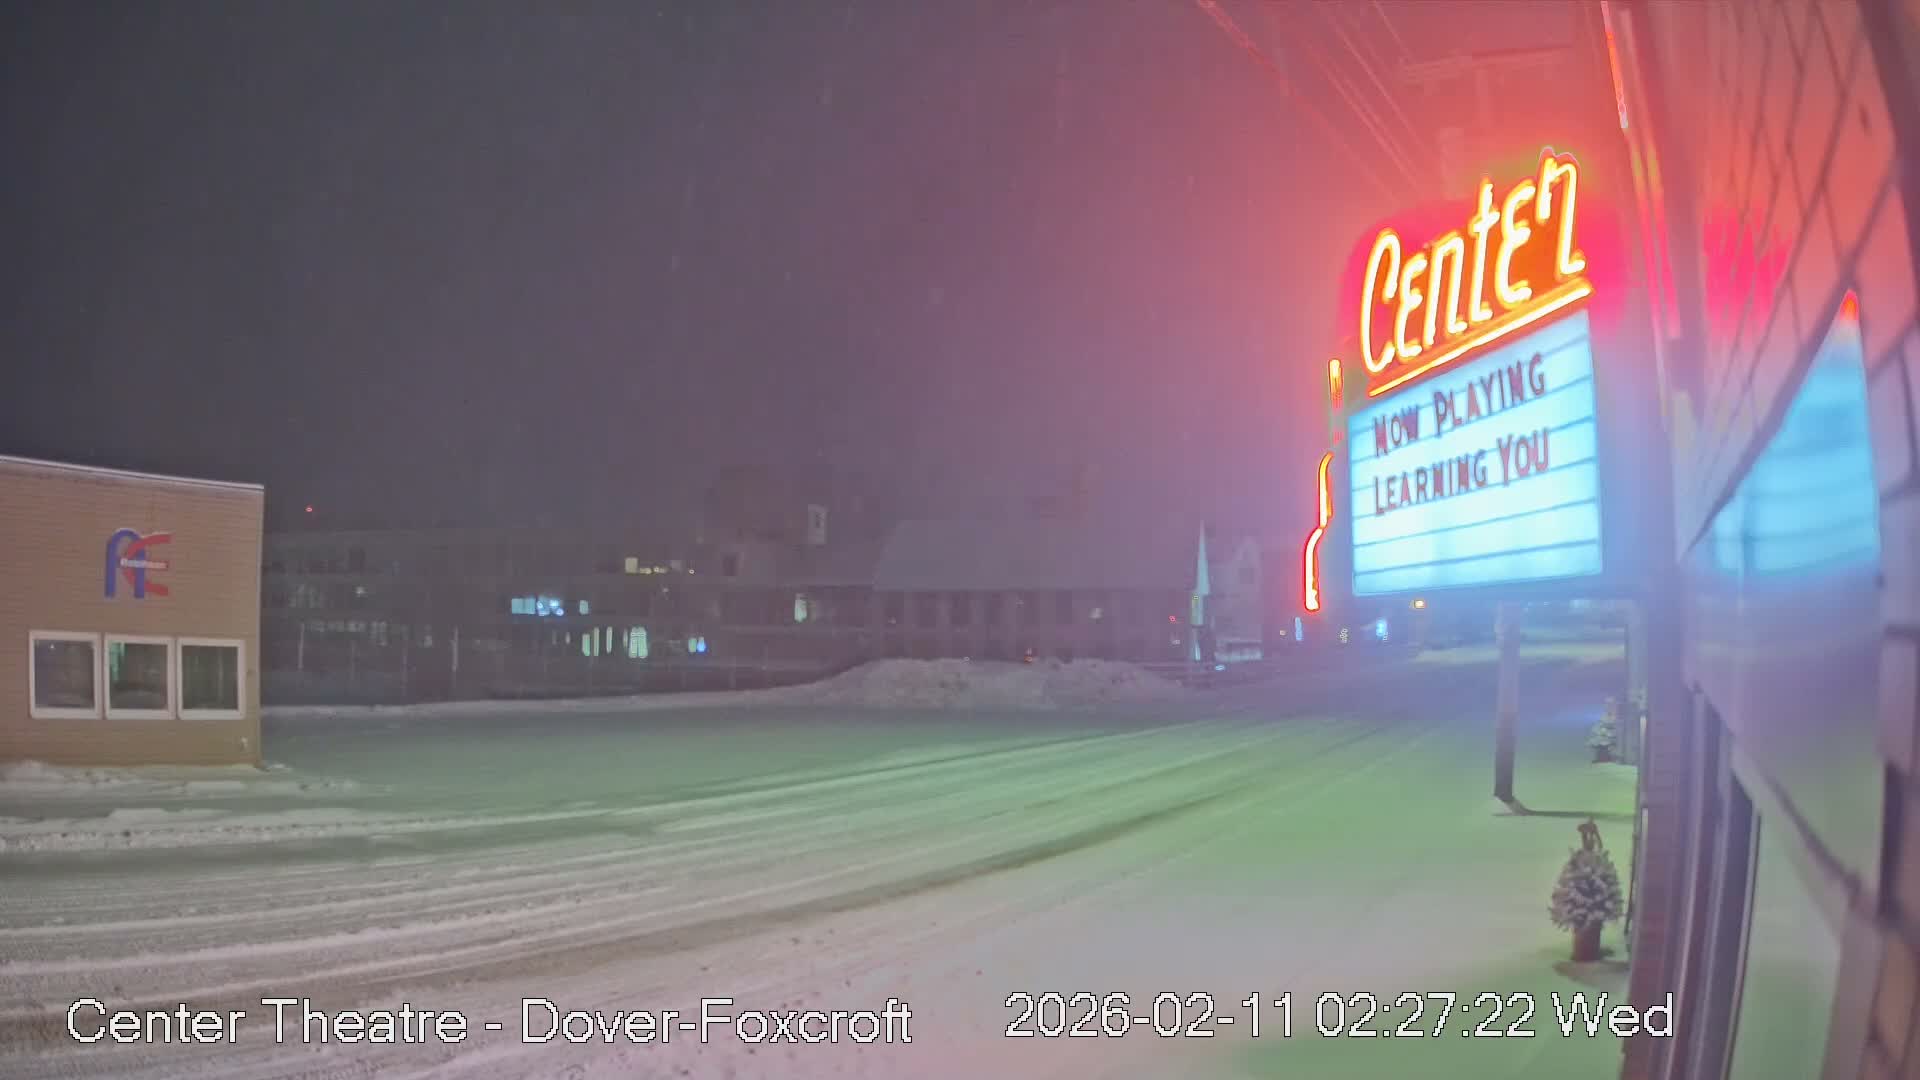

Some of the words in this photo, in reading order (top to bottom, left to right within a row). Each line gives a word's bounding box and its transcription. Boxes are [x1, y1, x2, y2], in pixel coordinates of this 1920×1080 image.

[1374, 404, 1419, 457] NOW
[1433, 352, 1545, 438] PLAYING
[1374, 448, 1487, 516] LEARNING
[1497, 426, 1550, 486] YOU
